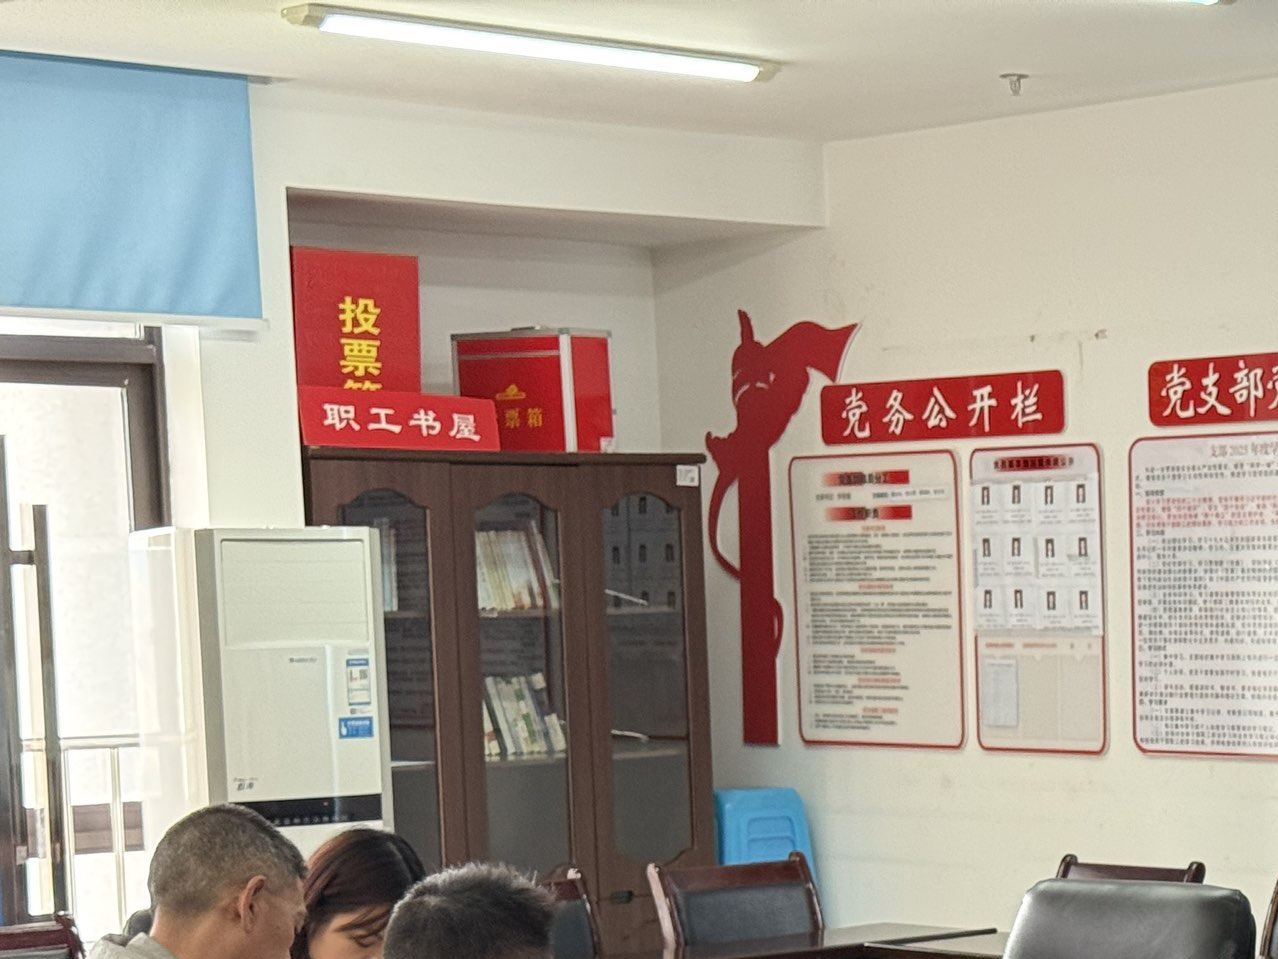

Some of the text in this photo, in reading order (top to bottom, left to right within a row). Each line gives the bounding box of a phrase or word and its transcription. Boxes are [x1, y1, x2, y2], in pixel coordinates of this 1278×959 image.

[322, 402, 481, 442] 职工书屋
[841, 380, 1043, 438] 党务公开栏
